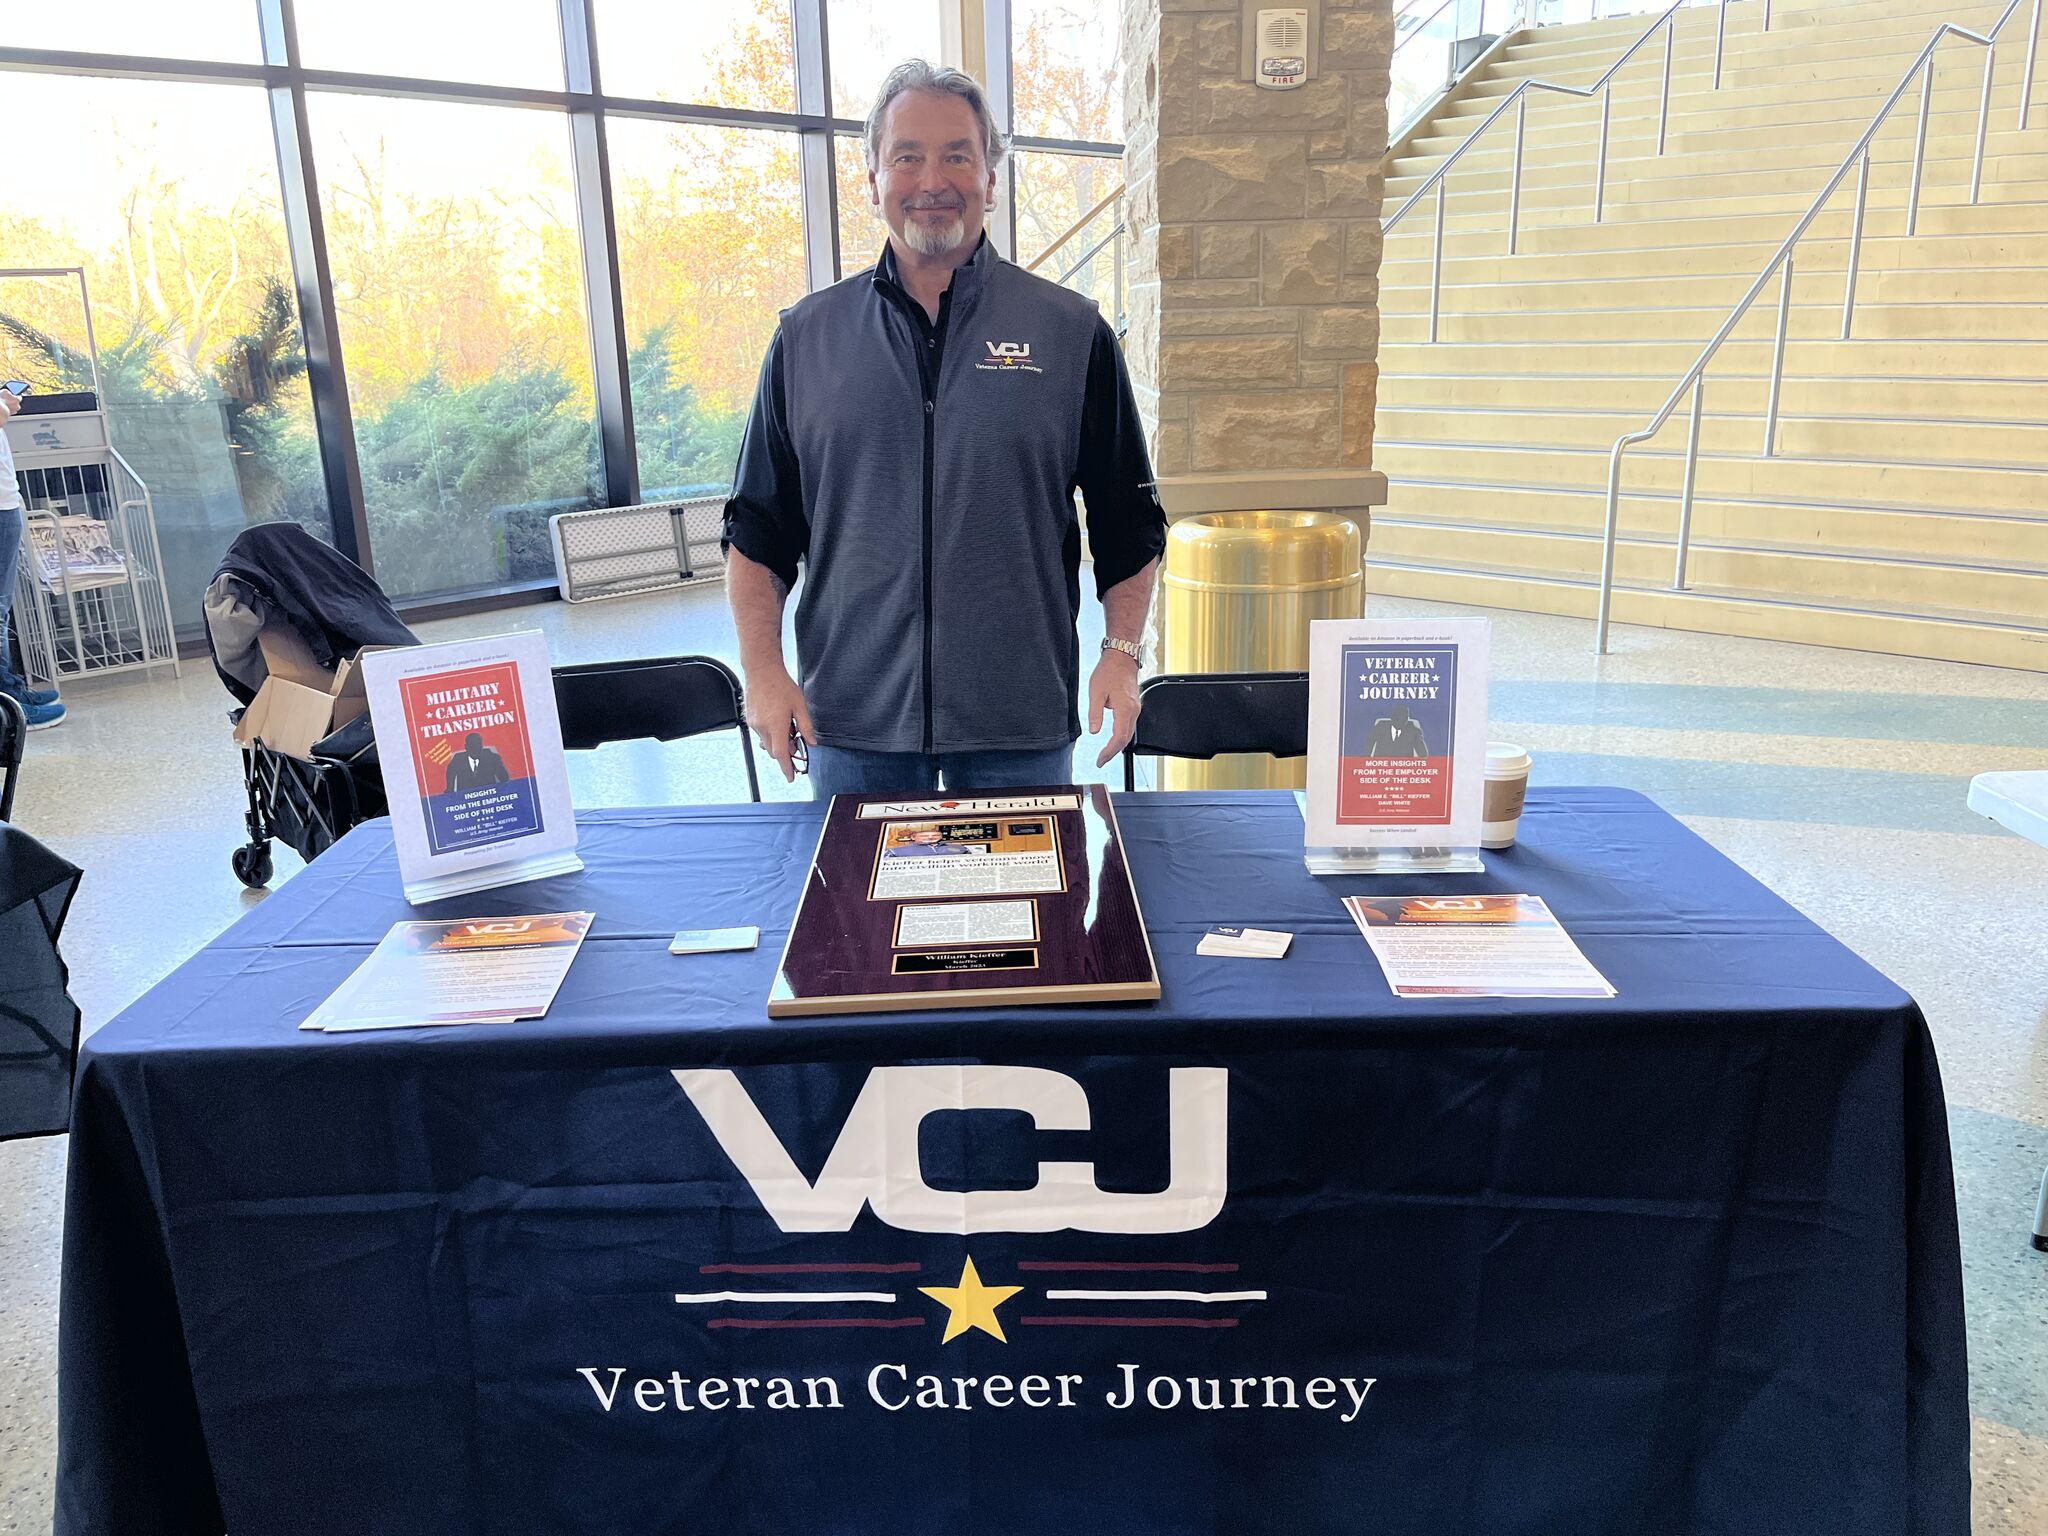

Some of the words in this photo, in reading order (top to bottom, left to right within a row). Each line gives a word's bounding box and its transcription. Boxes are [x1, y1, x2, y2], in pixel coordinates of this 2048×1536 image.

[986, 341, 1030, 357] VCJ
[1365, 657, 1436, 669] VETERAN
[1368, 672, 1431, 685] CAREER
[425, 682, 500, 706] MILITARY
[1359, 686, 1439, 700] JOURNEY
[435, 698, 497, 720] CAREER
[420, 710, 515, 738] TRANSITION
[1353, 768, 1376, 776] FROM
[1378, 768, 1394, 776] THE
[1395, 768, 1439, 776] EMPLOYER
[464, 788, 497, 800] INSIGHTS
[445, 803, 467, 813] FROM
[467, 800, 481, 809] THE
[481, 793, 519, 806] EMPLOYER
[972, 798, 1055, 810] Herald
[453, 811, 470, 821] SIDE
[470, 809, 480, 817] OF
[481, 806, 495, 815] THE
[495, 803, 514, 812] DESK
[454, 825, 477, 834] WILLIAM
[1414, 900, 1484, 910] VCJ
[466, 922, 532, 935] VCJ
[670, 1066, 1228, 1235] VCJ
[576, 1366, 844, 1414] Veteran
[867, 1363, 1083, 1412] Career
[1106, 1363, 1378, 1423] Journey
